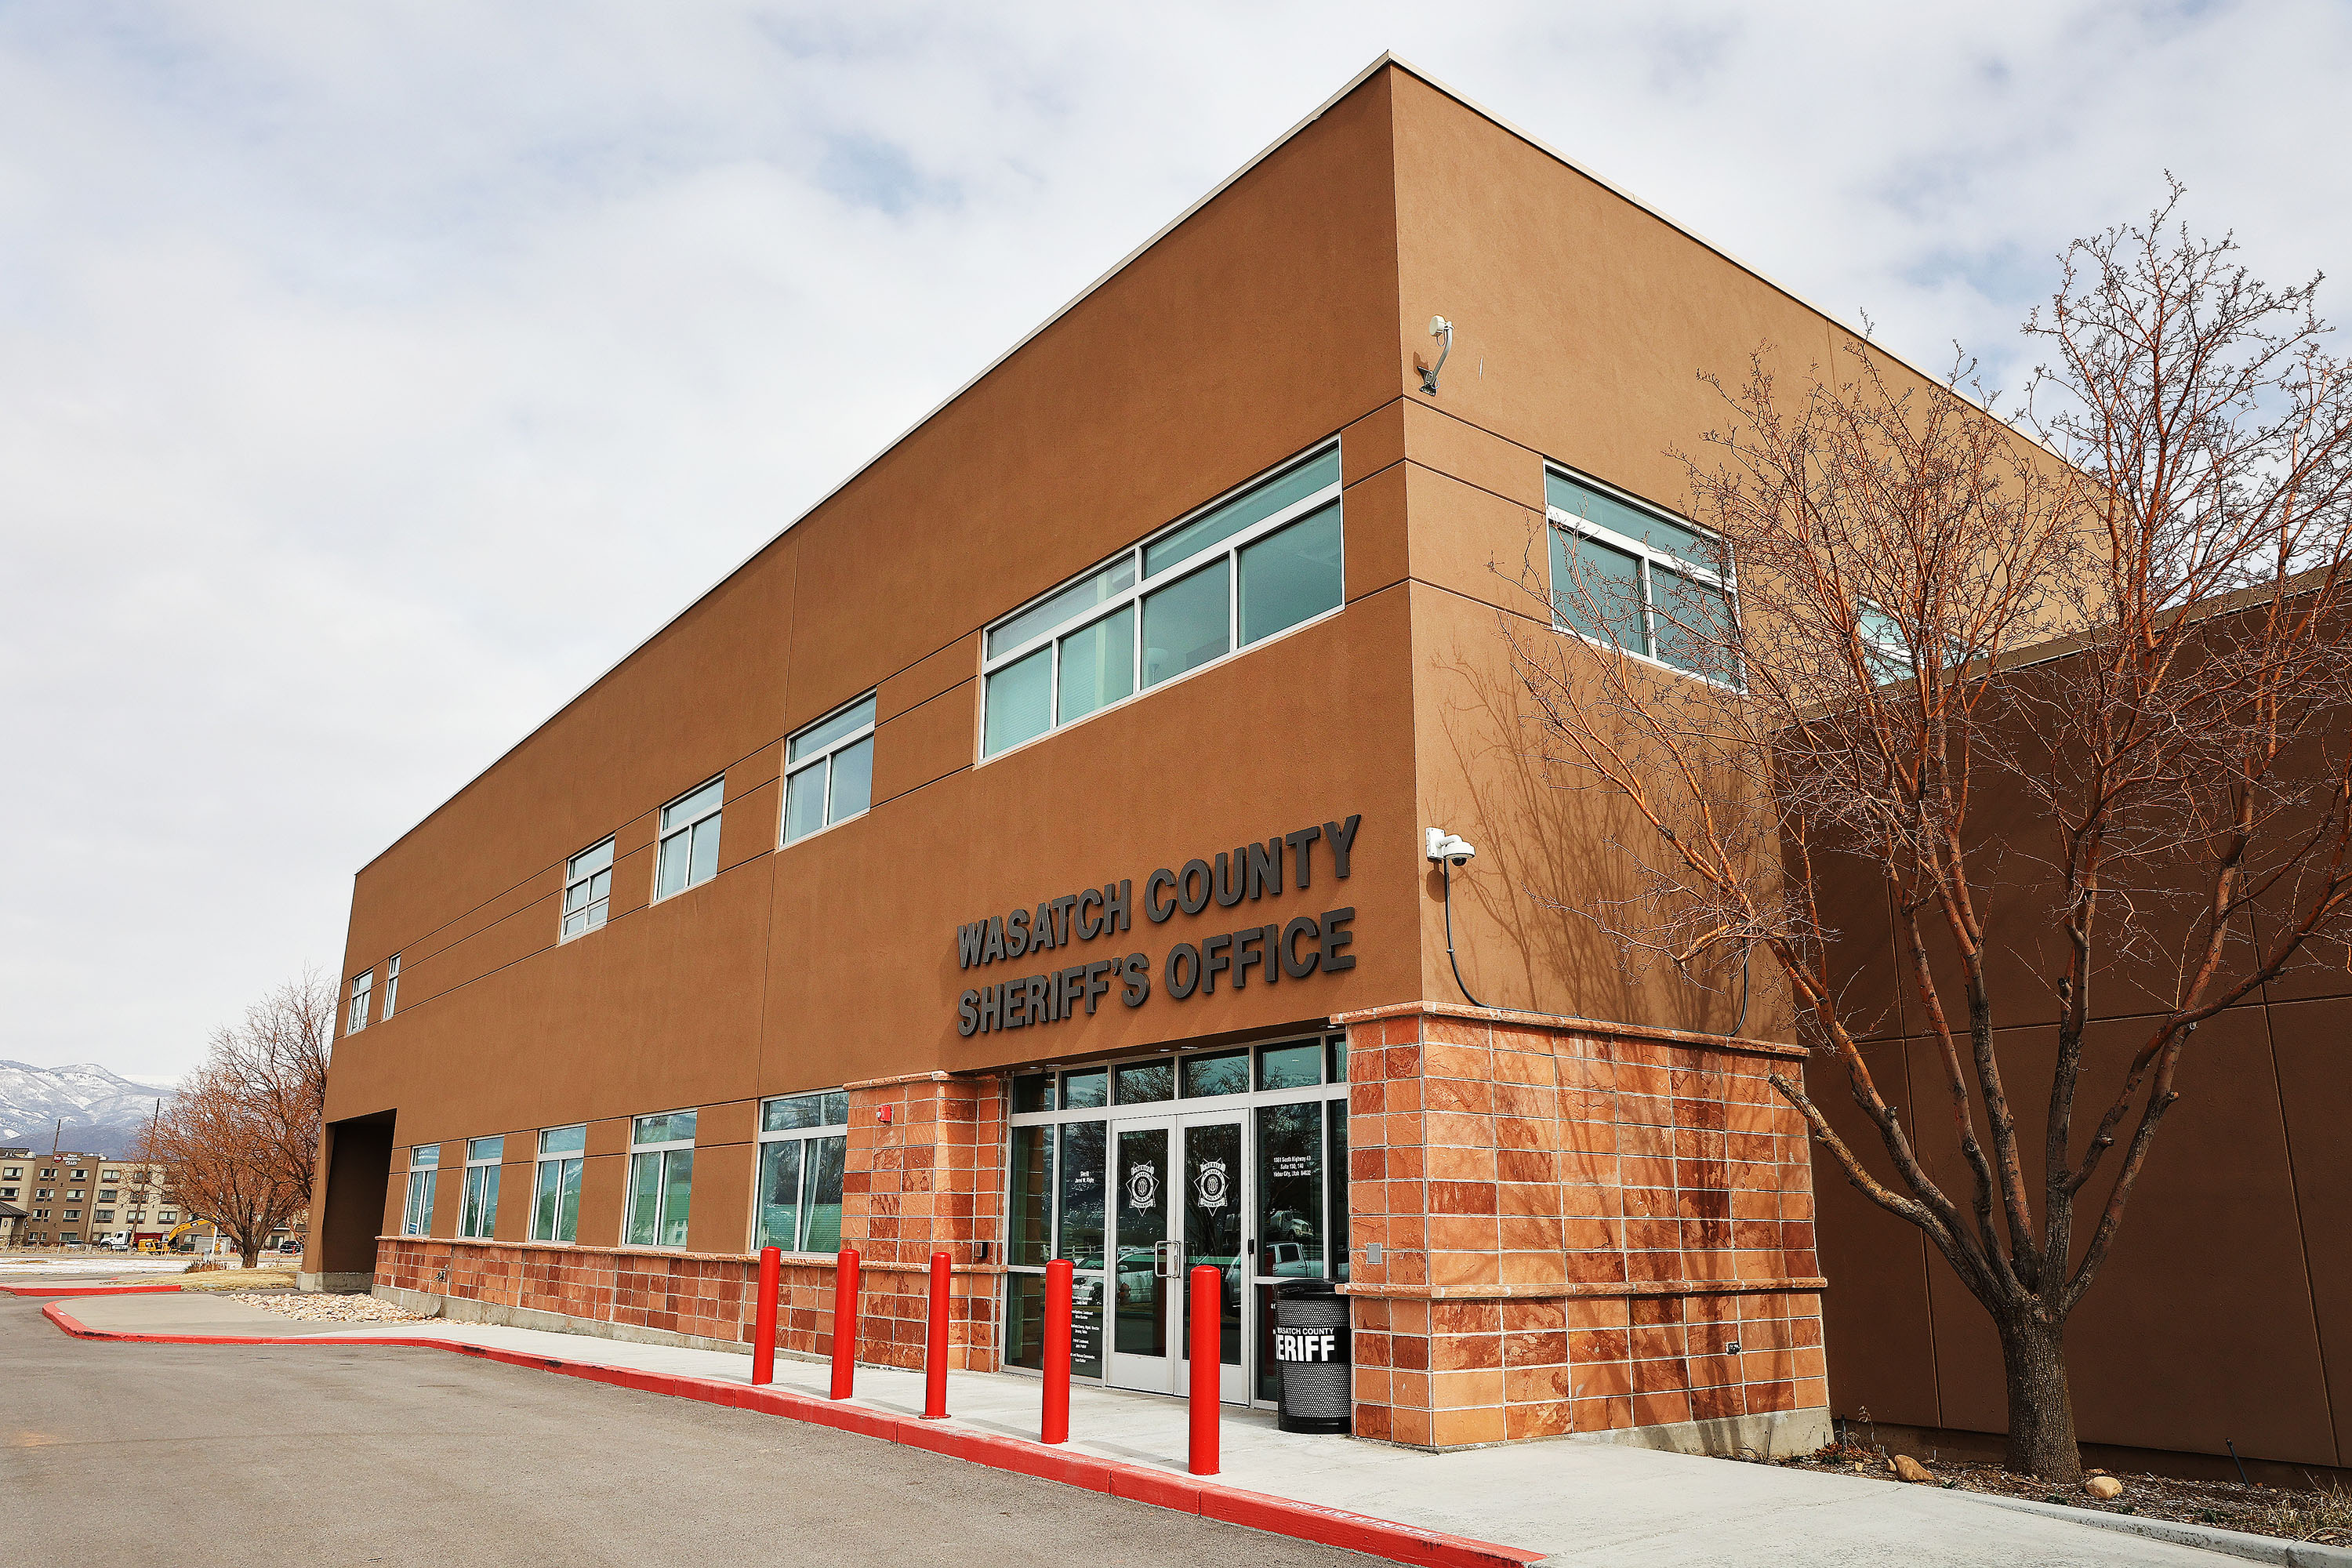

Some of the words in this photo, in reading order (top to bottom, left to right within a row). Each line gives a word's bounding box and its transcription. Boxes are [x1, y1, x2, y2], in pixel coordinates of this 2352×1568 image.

[956, 880, 1131, 968] WASATCH
[1145, 814, 1362, 923] COUNTY
[957, 953, 1149, 1036] SHERIFF'S
[1165, 907, 1356, 1000] OFFICE
[1276, 1334, 1335, 1362] ERIFF
[1313, 1508, 1356, 1518] LANE
[1374, 1521, 1443, 1537] PARKING
